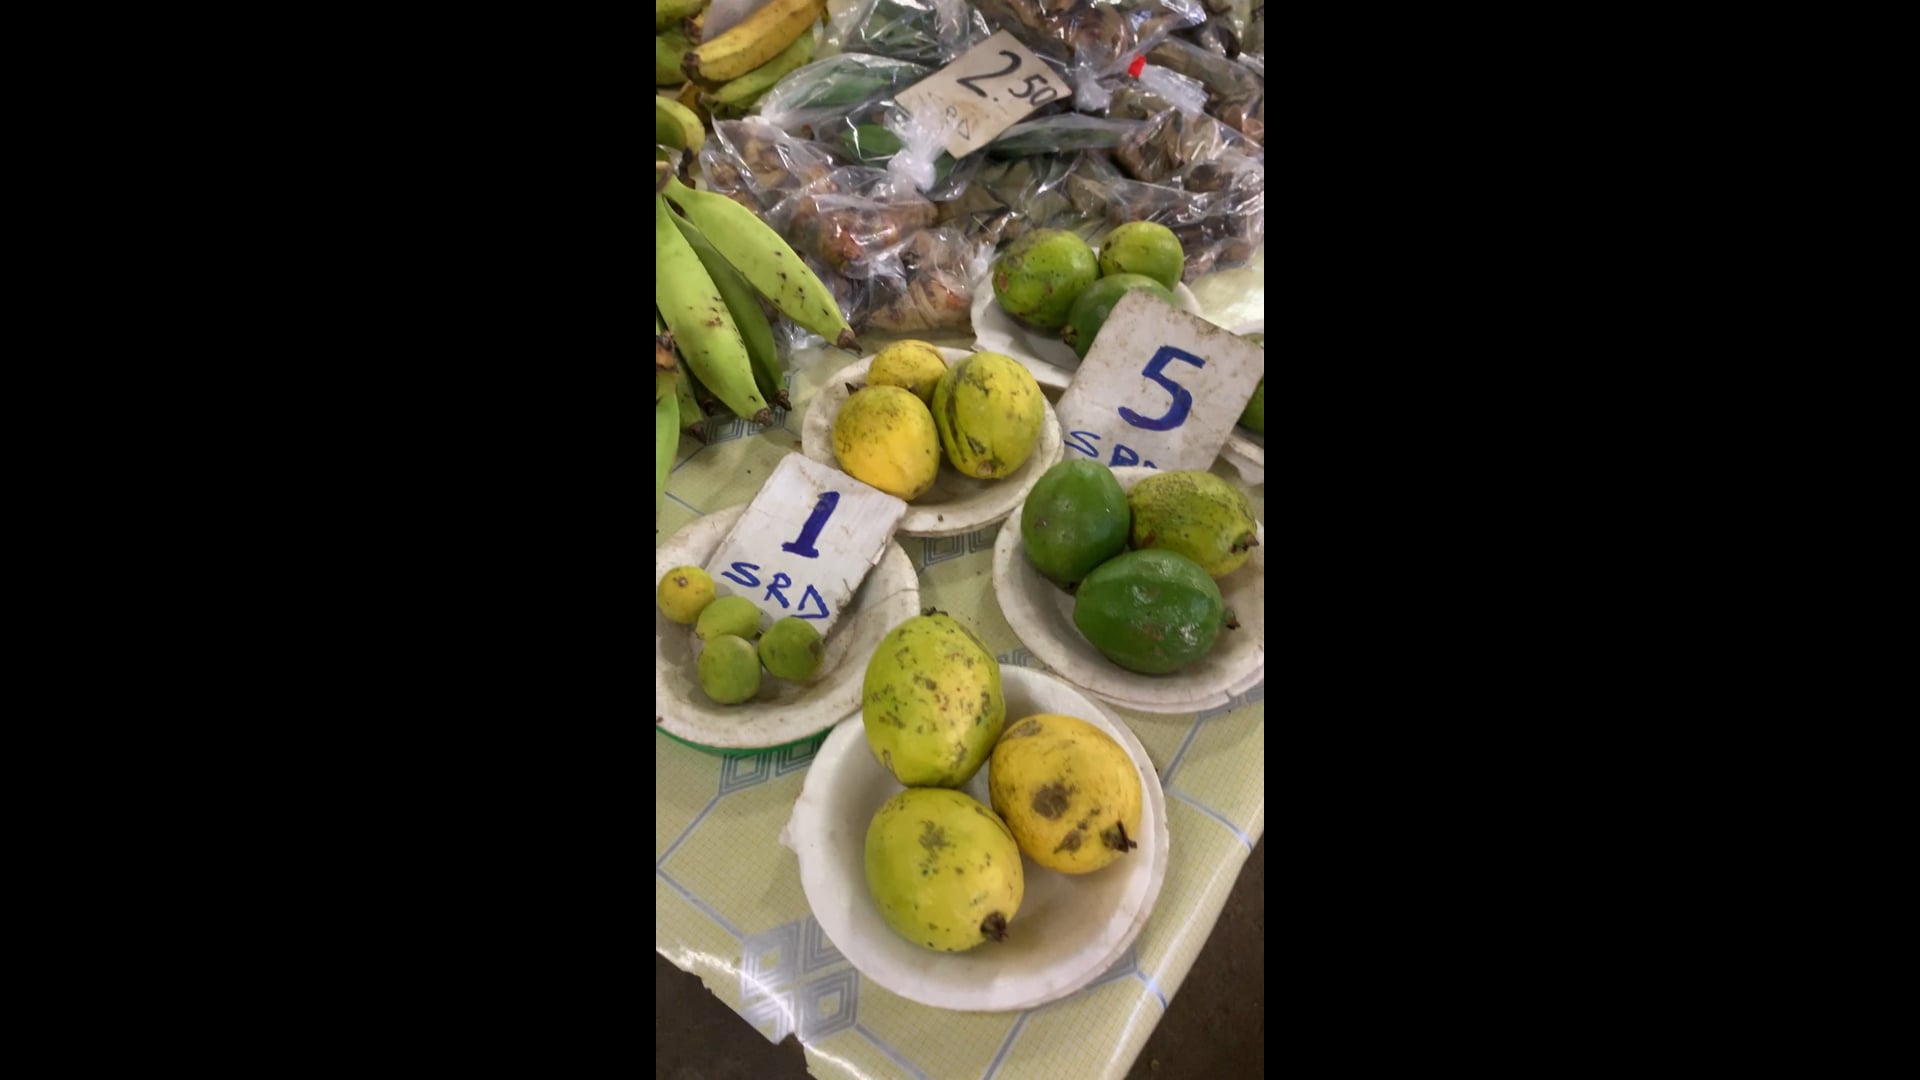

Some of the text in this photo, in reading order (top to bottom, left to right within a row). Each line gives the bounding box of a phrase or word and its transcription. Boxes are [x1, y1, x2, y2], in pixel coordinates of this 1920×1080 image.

[1118, 344, 1206, 432] 5
[781, 491, 840, 559] 1
[721, 561, 830, 619] SRD
